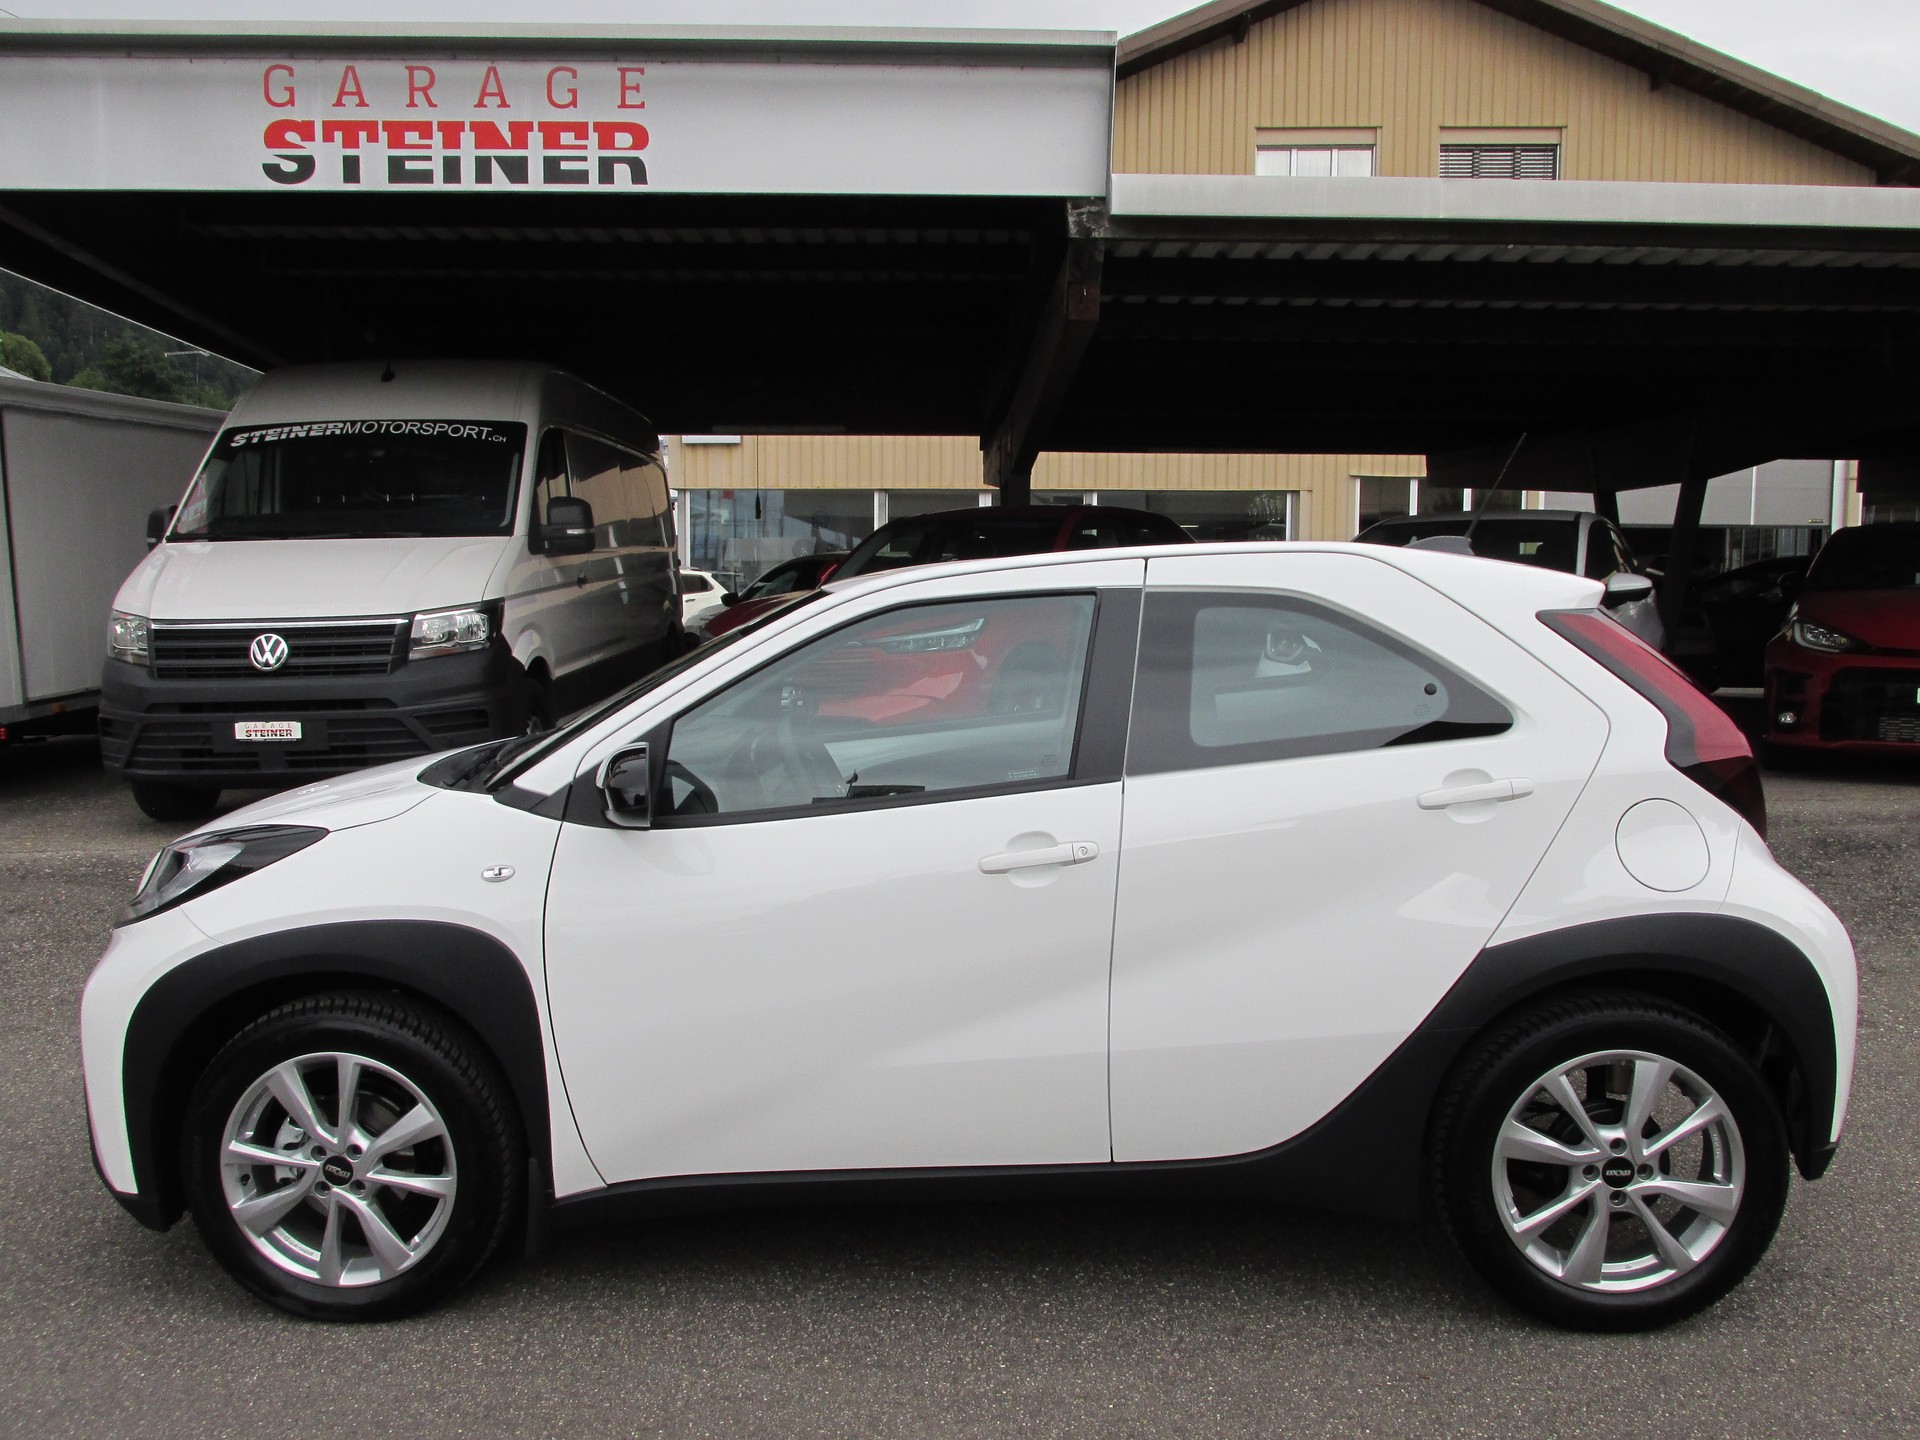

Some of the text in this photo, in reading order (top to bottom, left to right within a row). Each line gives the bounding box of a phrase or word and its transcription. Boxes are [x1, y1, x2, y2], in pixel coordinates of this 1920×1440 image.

[262, 64, 646, 109] GARAGE
[262, 119, 649, 185] STEINER
[245, 729, 293, 738] STEINER
